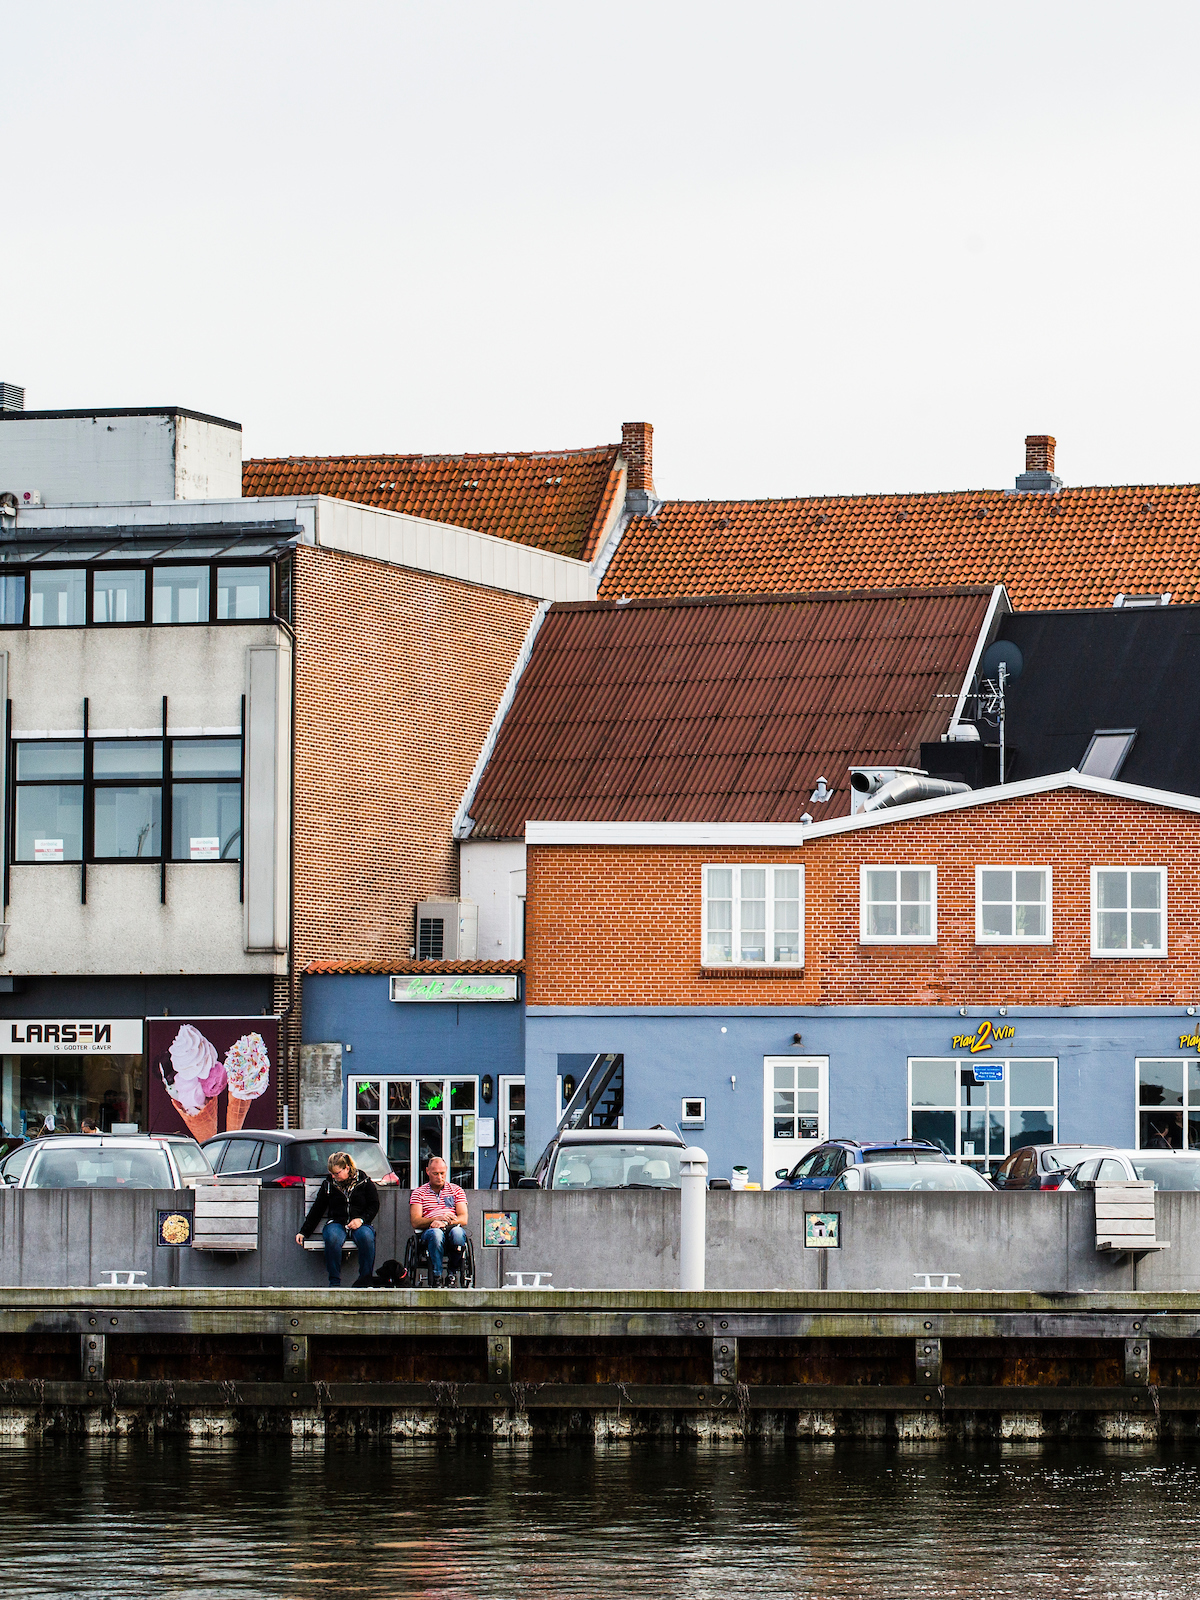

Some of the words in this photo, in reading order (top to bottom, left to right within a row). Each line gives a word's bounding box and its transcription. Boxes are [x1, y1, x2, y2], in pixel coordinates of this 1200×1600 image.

[406, 978, 444, 999] Café
[446, 979, 505, 995] Larsen
[11, 1024, 111, 1043] LARSEN
[952, 1034, 976, 1049] Play
[970, 1021, 993, 1053] 2
[992, 1025, 1015, 1041] Win
